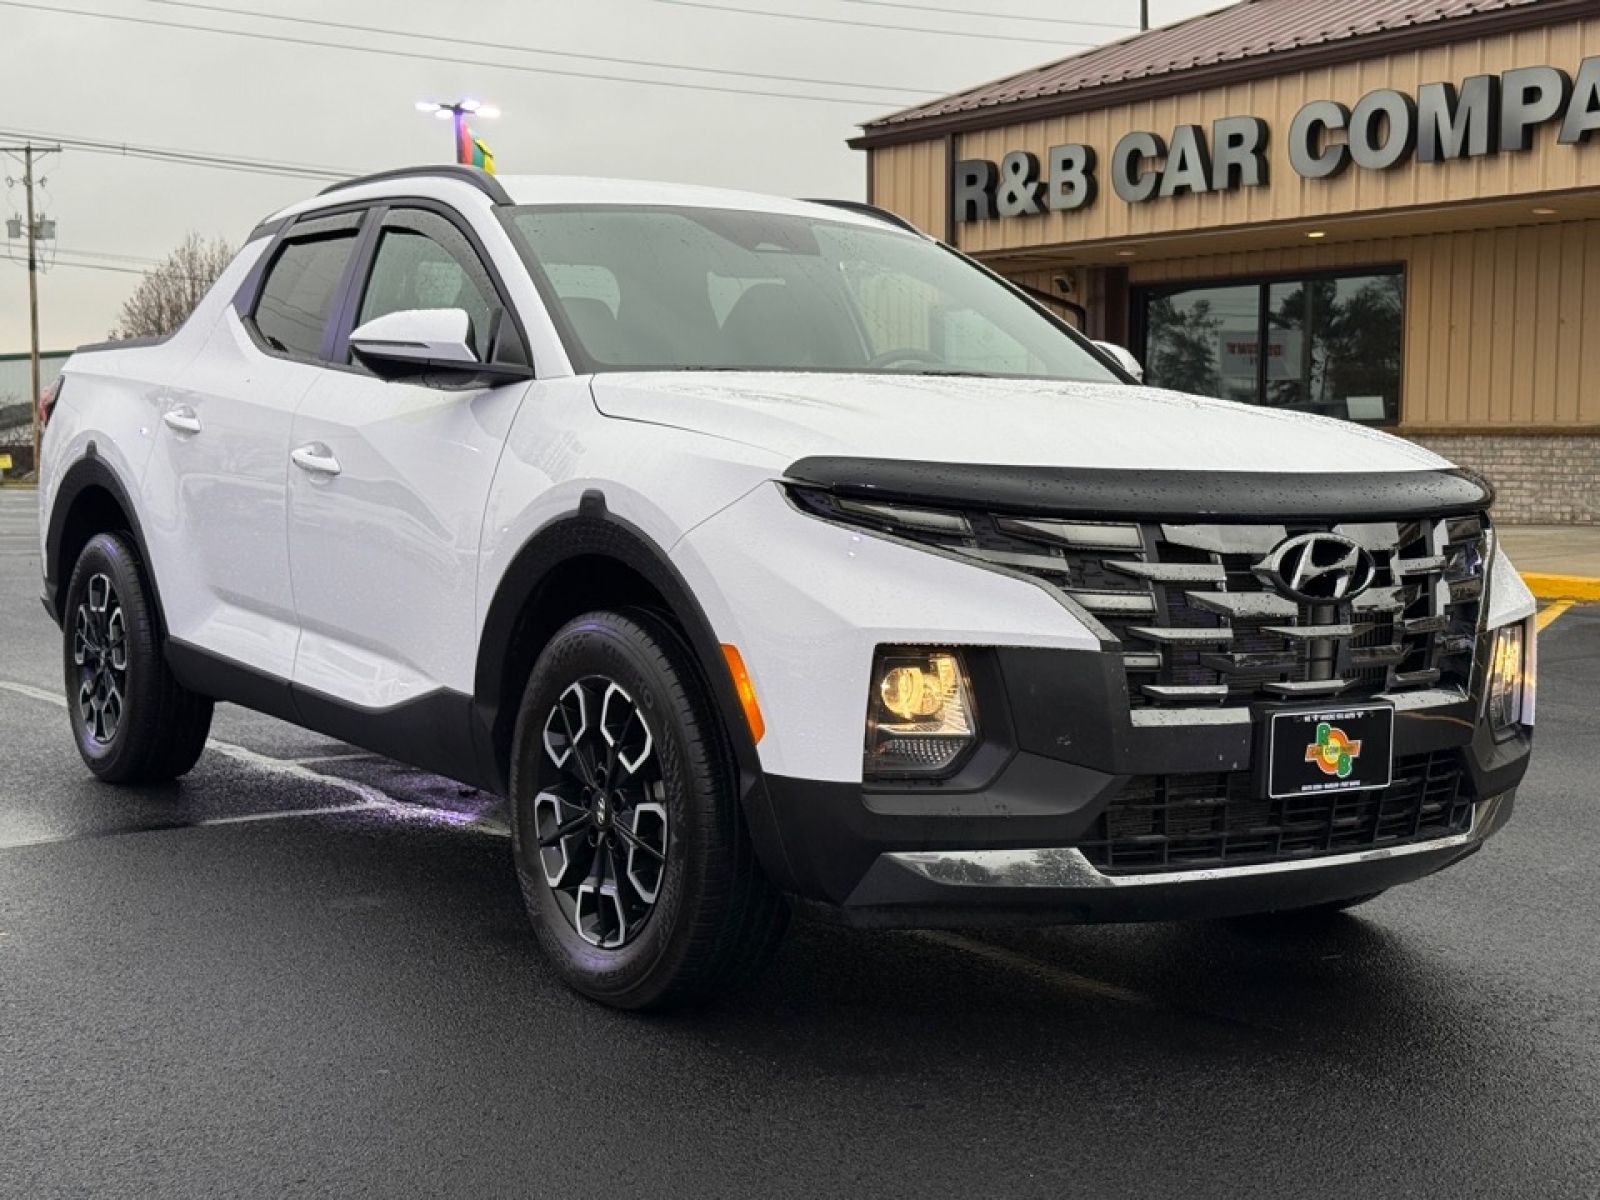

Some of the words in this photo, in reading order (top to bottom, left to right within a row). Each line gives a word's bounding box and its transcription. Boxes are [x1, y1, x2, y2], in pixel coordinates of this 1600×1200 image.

[955, 143, 1096, 221] R&B
[1111, 116, 1268, 203] CAR
[1288, 55, 1600, 179] COMPA
